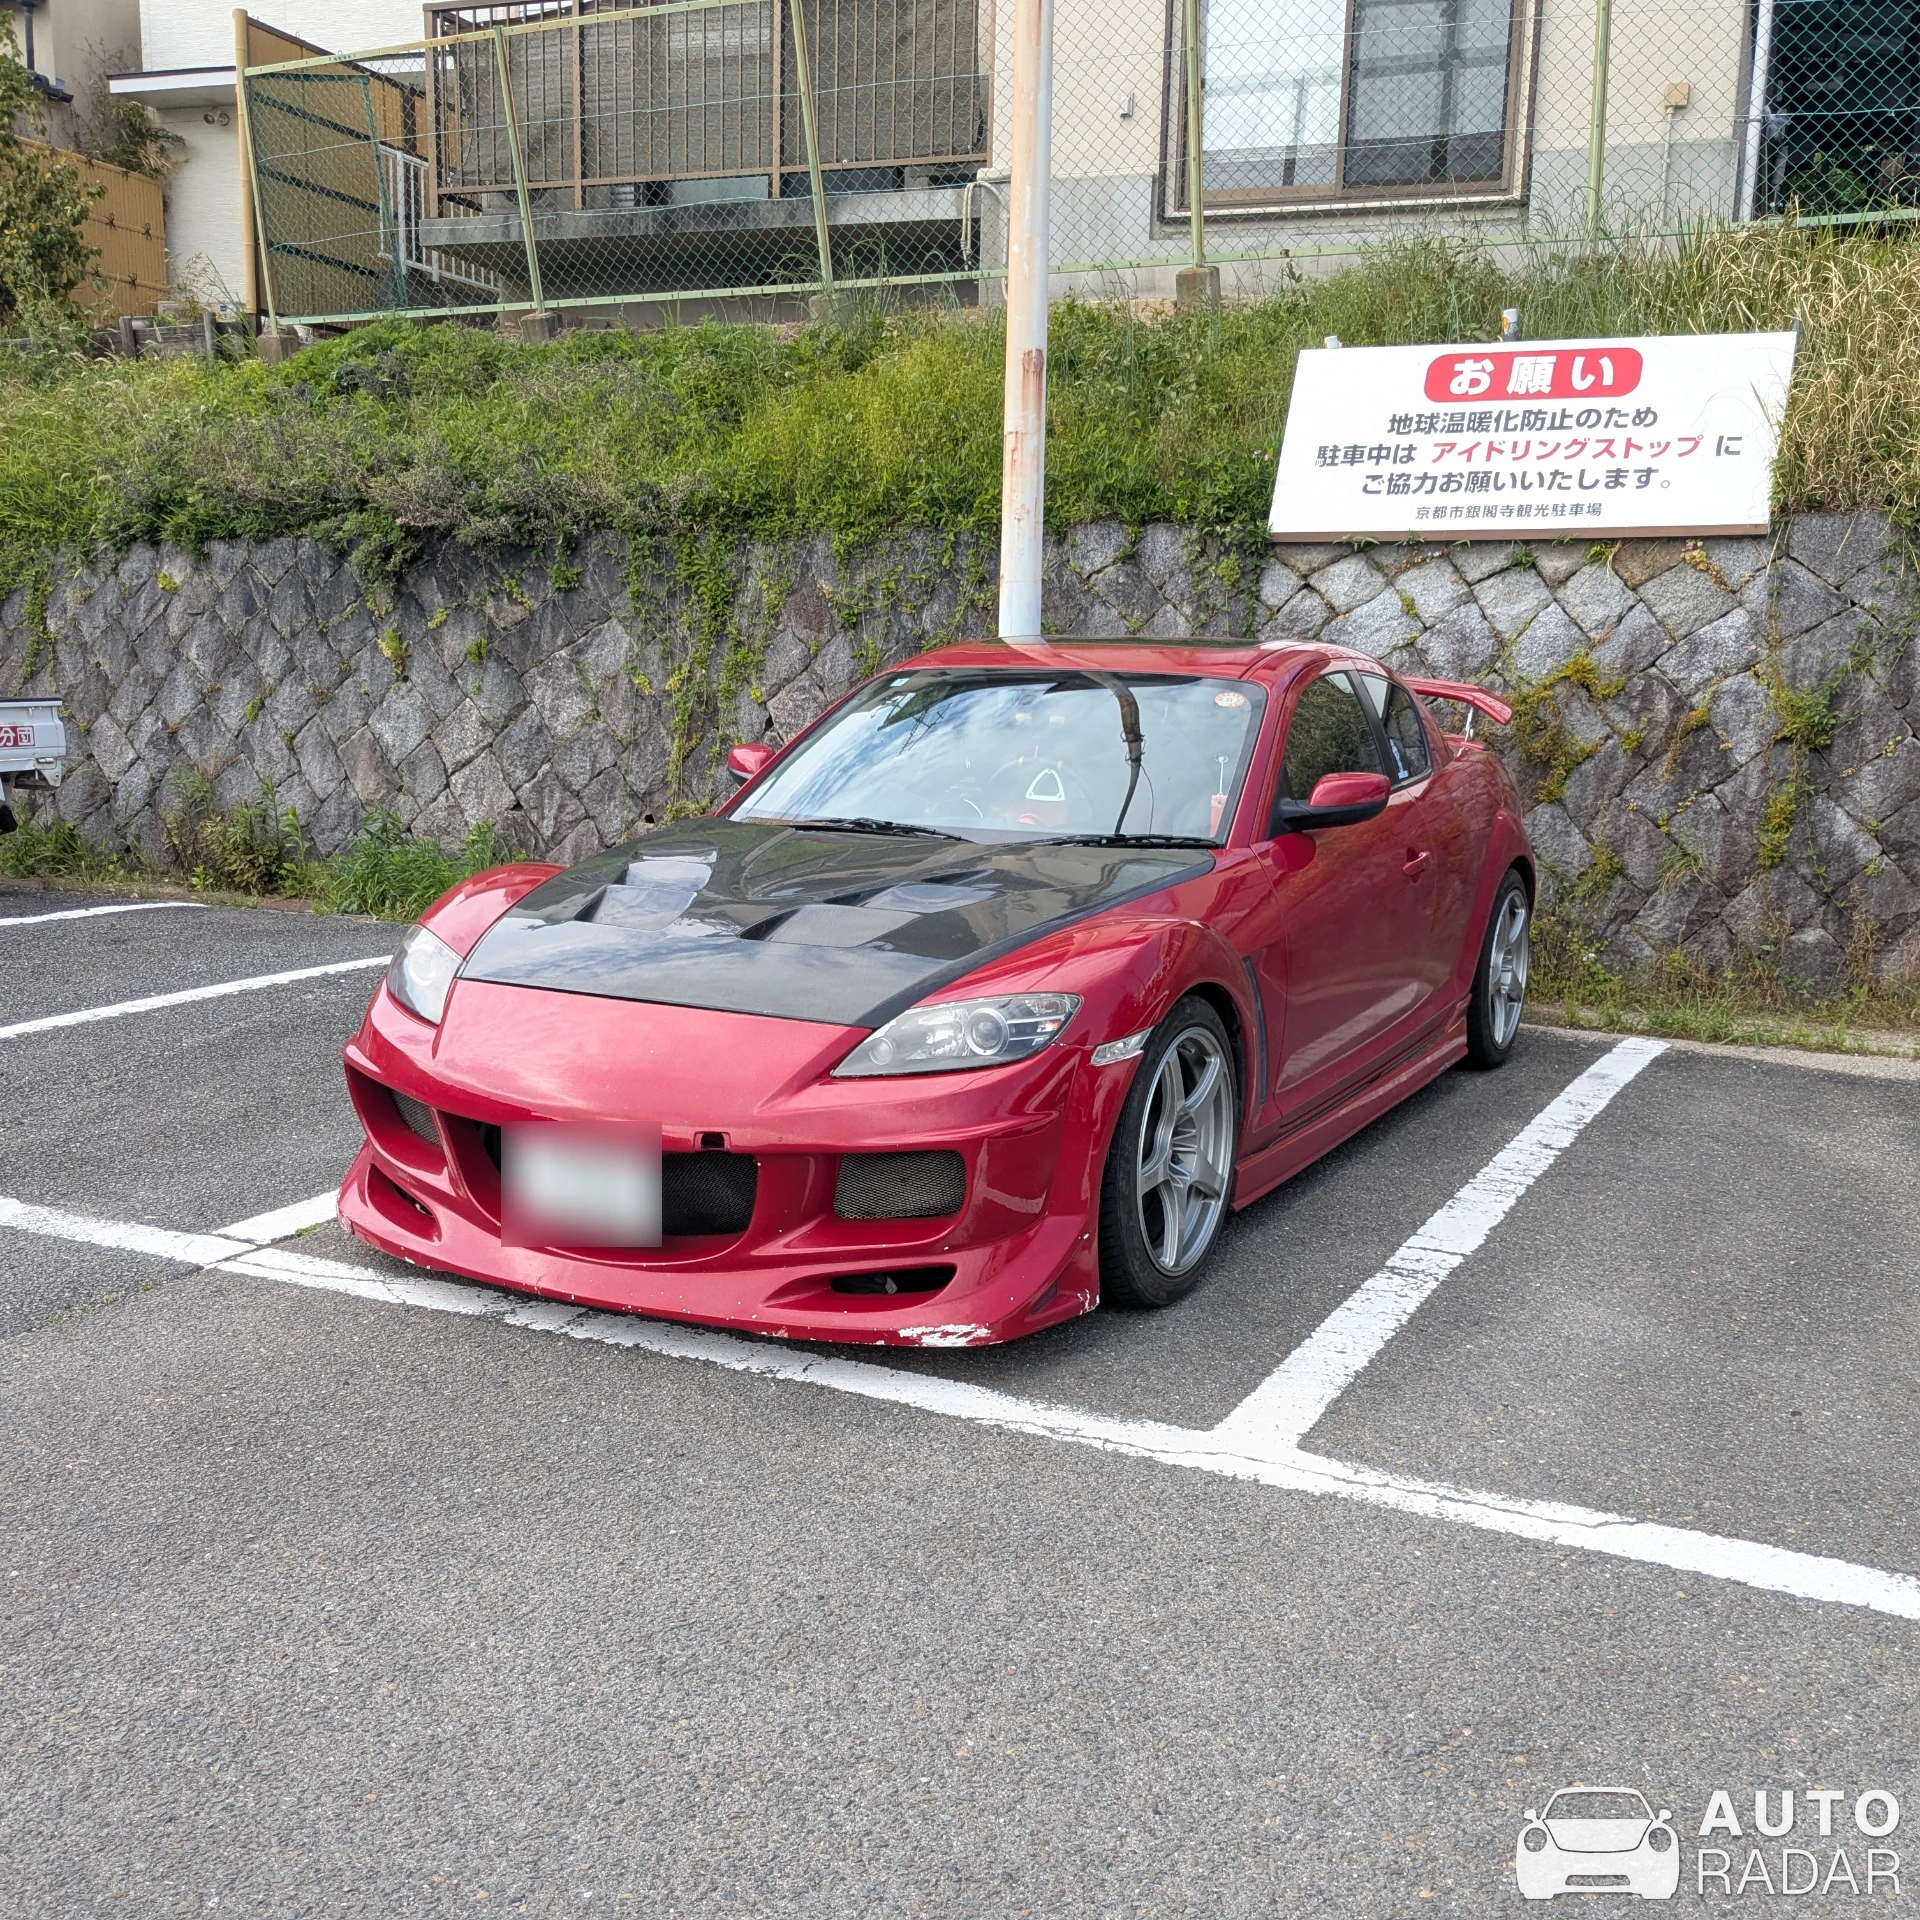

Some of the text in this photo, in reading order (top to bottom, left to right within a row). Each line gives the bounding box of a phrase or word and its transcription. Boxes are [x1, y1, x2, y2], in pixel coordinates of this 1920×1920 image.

[1449, 355, 1614, 395] お願い
[1387, 406, 1658, 435] 地球温暖化防止のため
[1315, 434, 1743, 467] 駐車中は アイドリングストップ に
[1362, 466, 1671, 495] ご協力お願いいたします。
[1415, 502, 1602, 520] 京都市銀閣寺観光駐車場
